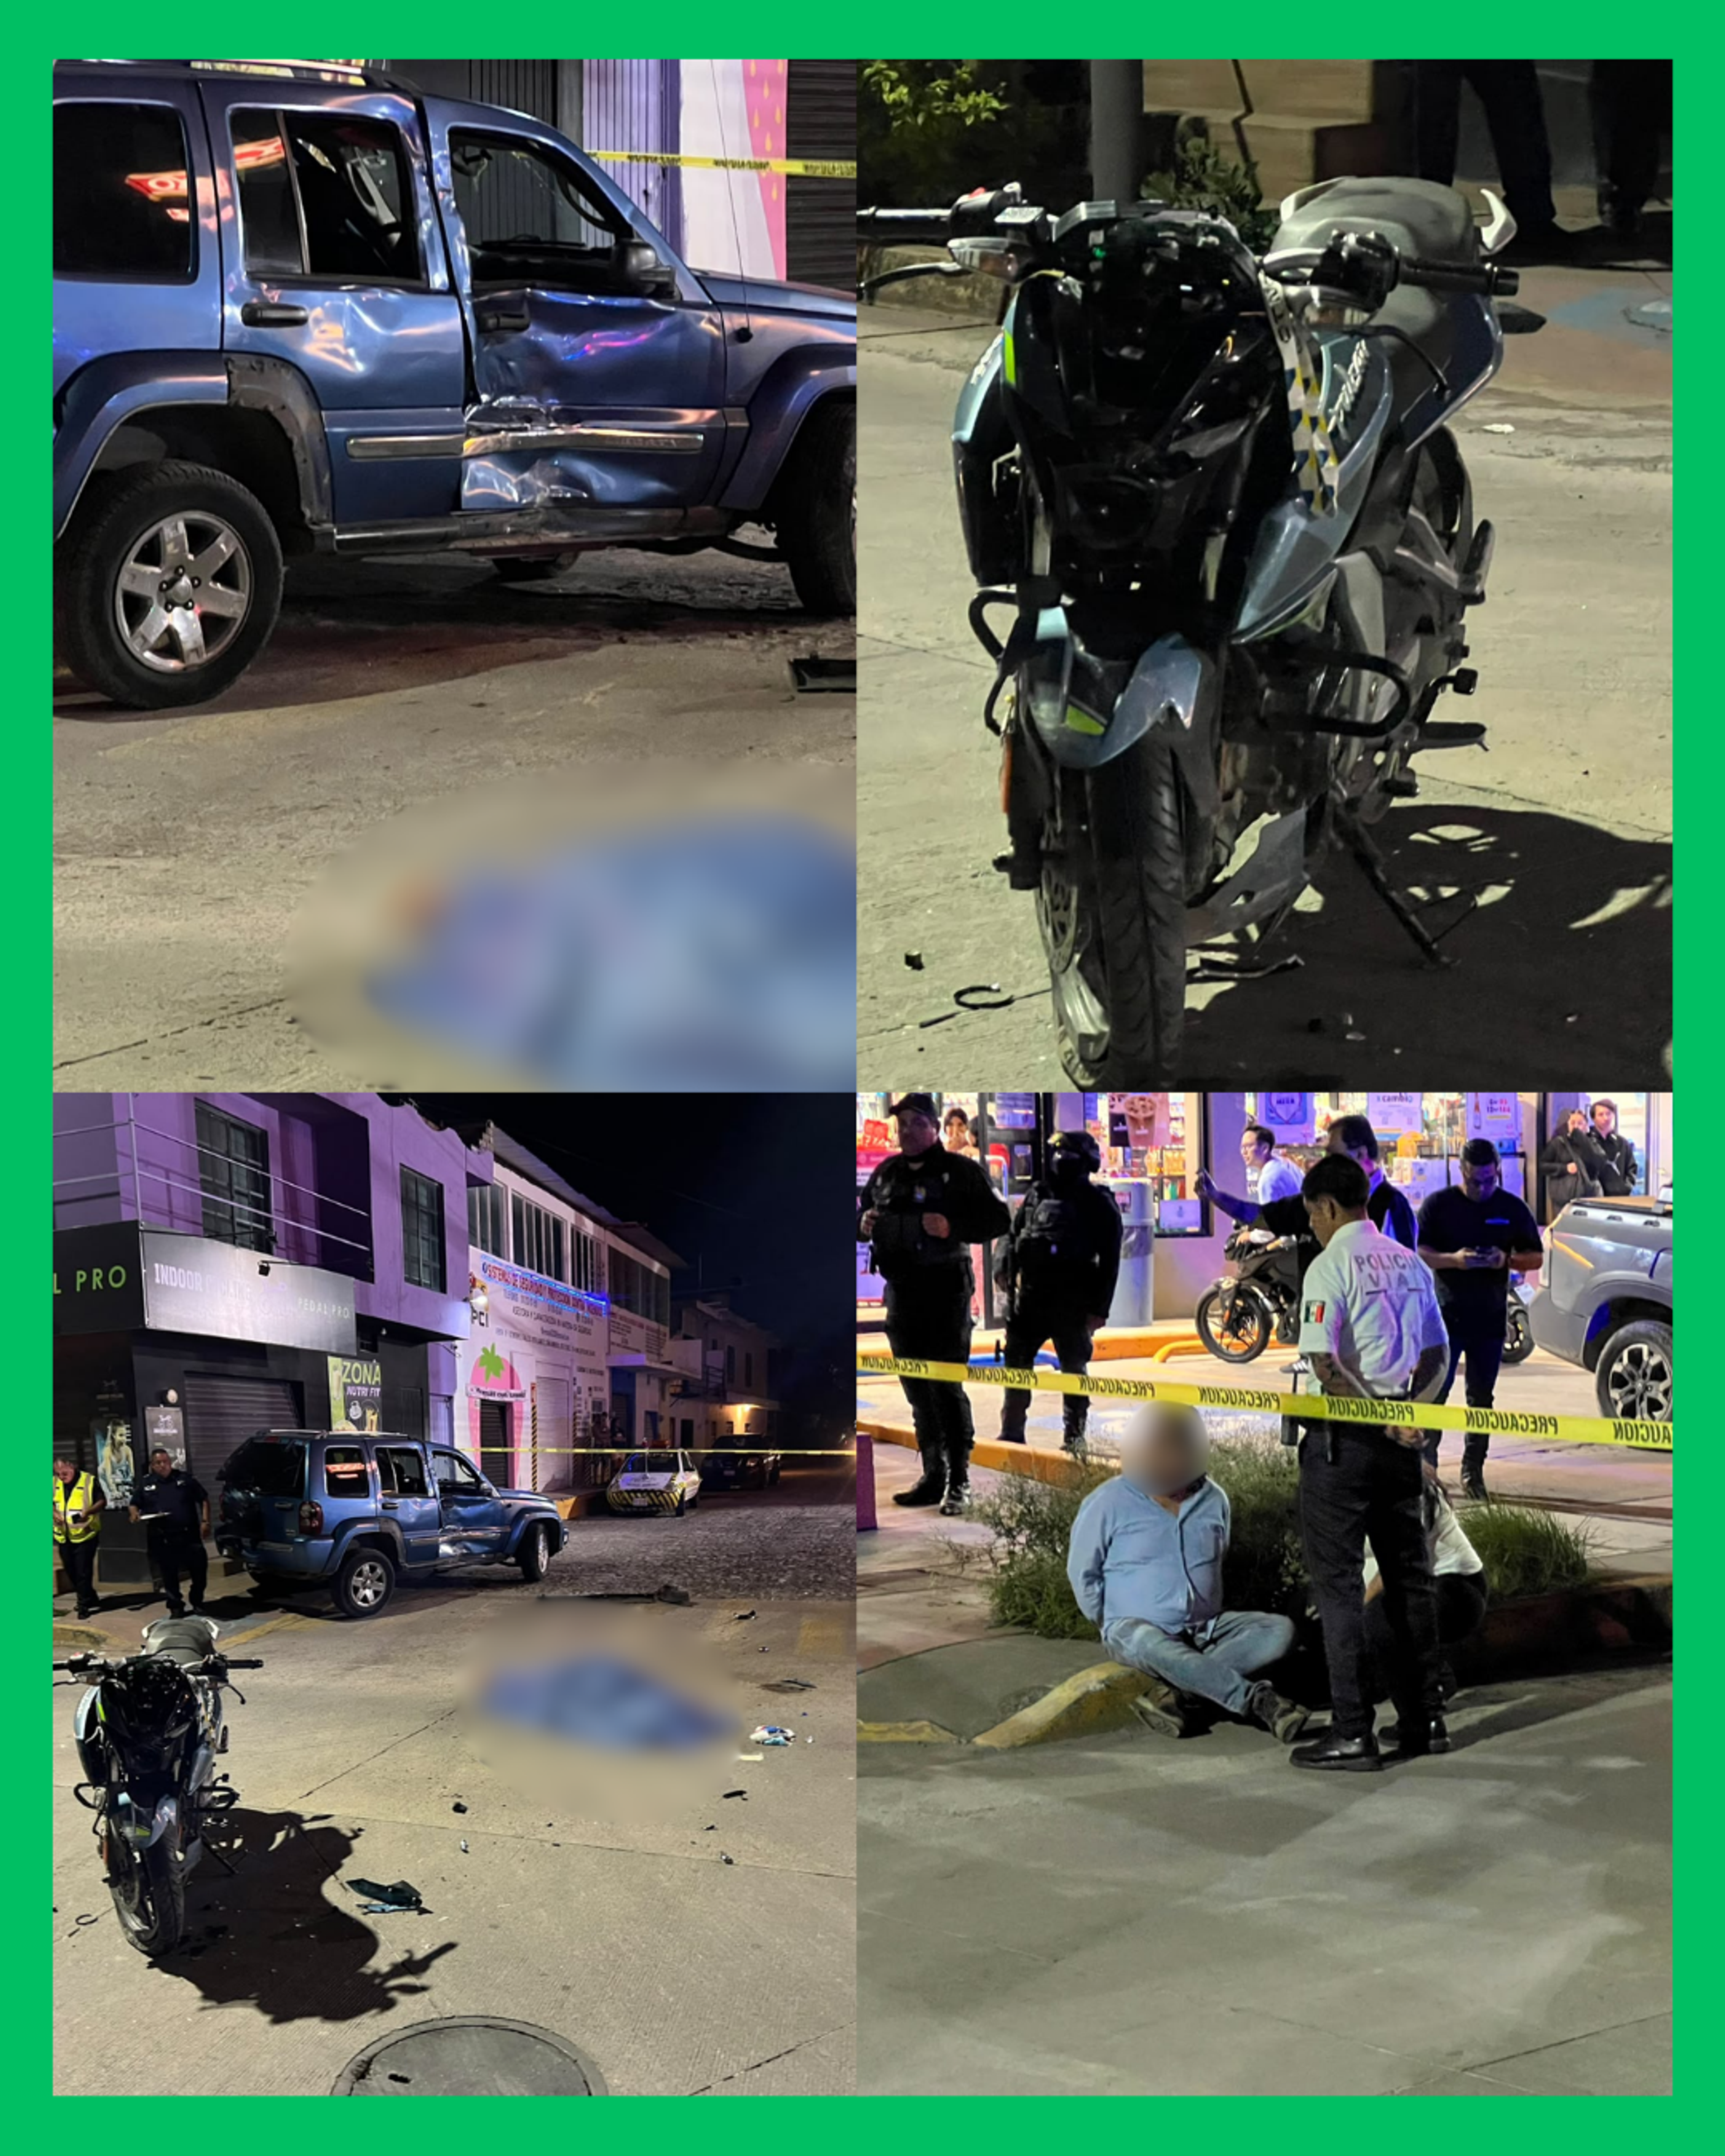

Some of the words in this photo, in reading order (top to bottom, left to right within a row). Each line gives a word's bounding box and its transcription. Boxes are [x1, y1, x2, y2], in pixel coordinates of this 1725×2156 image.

[76, 1265, 126, 1292] PRO
[155, 1263, 203, 1292] INDOOR
[298, 1297, 327, 1316] PEDAL
[332, 1304, 350, 1319] PRO
[471, 1306, 489, 1327] PCI
[342, 1361, 381, 1385] ZONA
[347, 1386, 368, 1396] NUTRI
[369, 1387, 380, 1397] FIT
